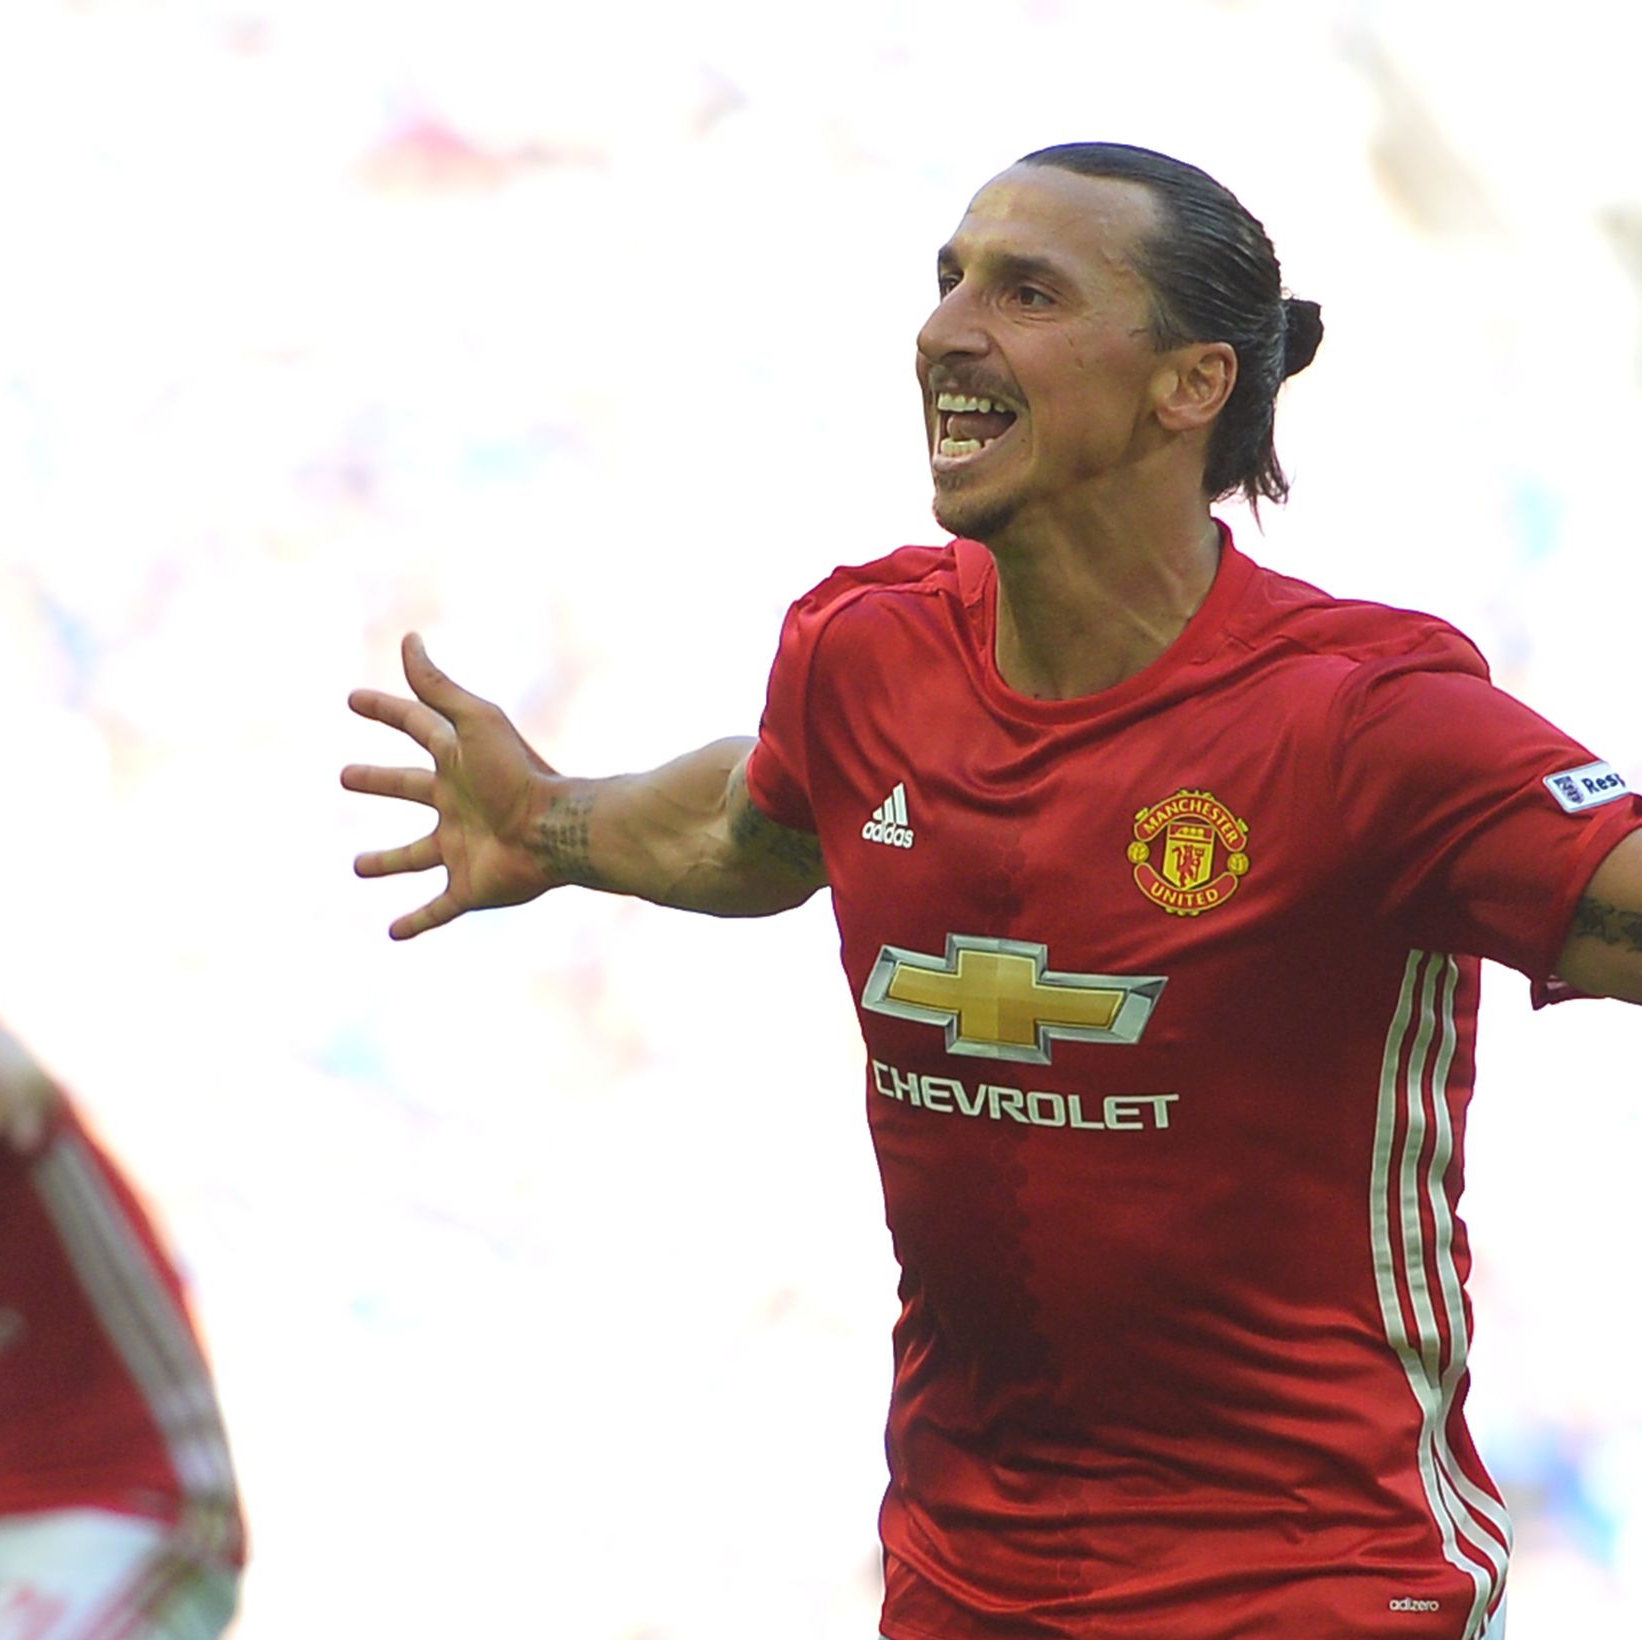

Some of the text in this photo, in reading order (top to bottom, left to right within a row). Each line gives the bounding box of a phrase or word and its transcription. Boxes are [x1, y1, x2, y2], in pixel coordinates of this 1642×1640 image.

[861, 819, 914, 849] adidas
[1143, 798, 1239, 844] MANCHESTER
[1150, 881, 1219, 907] UNITED
[871, 1058, 1181, 1131] CHEVROLET
[1389, 1596, 1440, 1612] adizero
